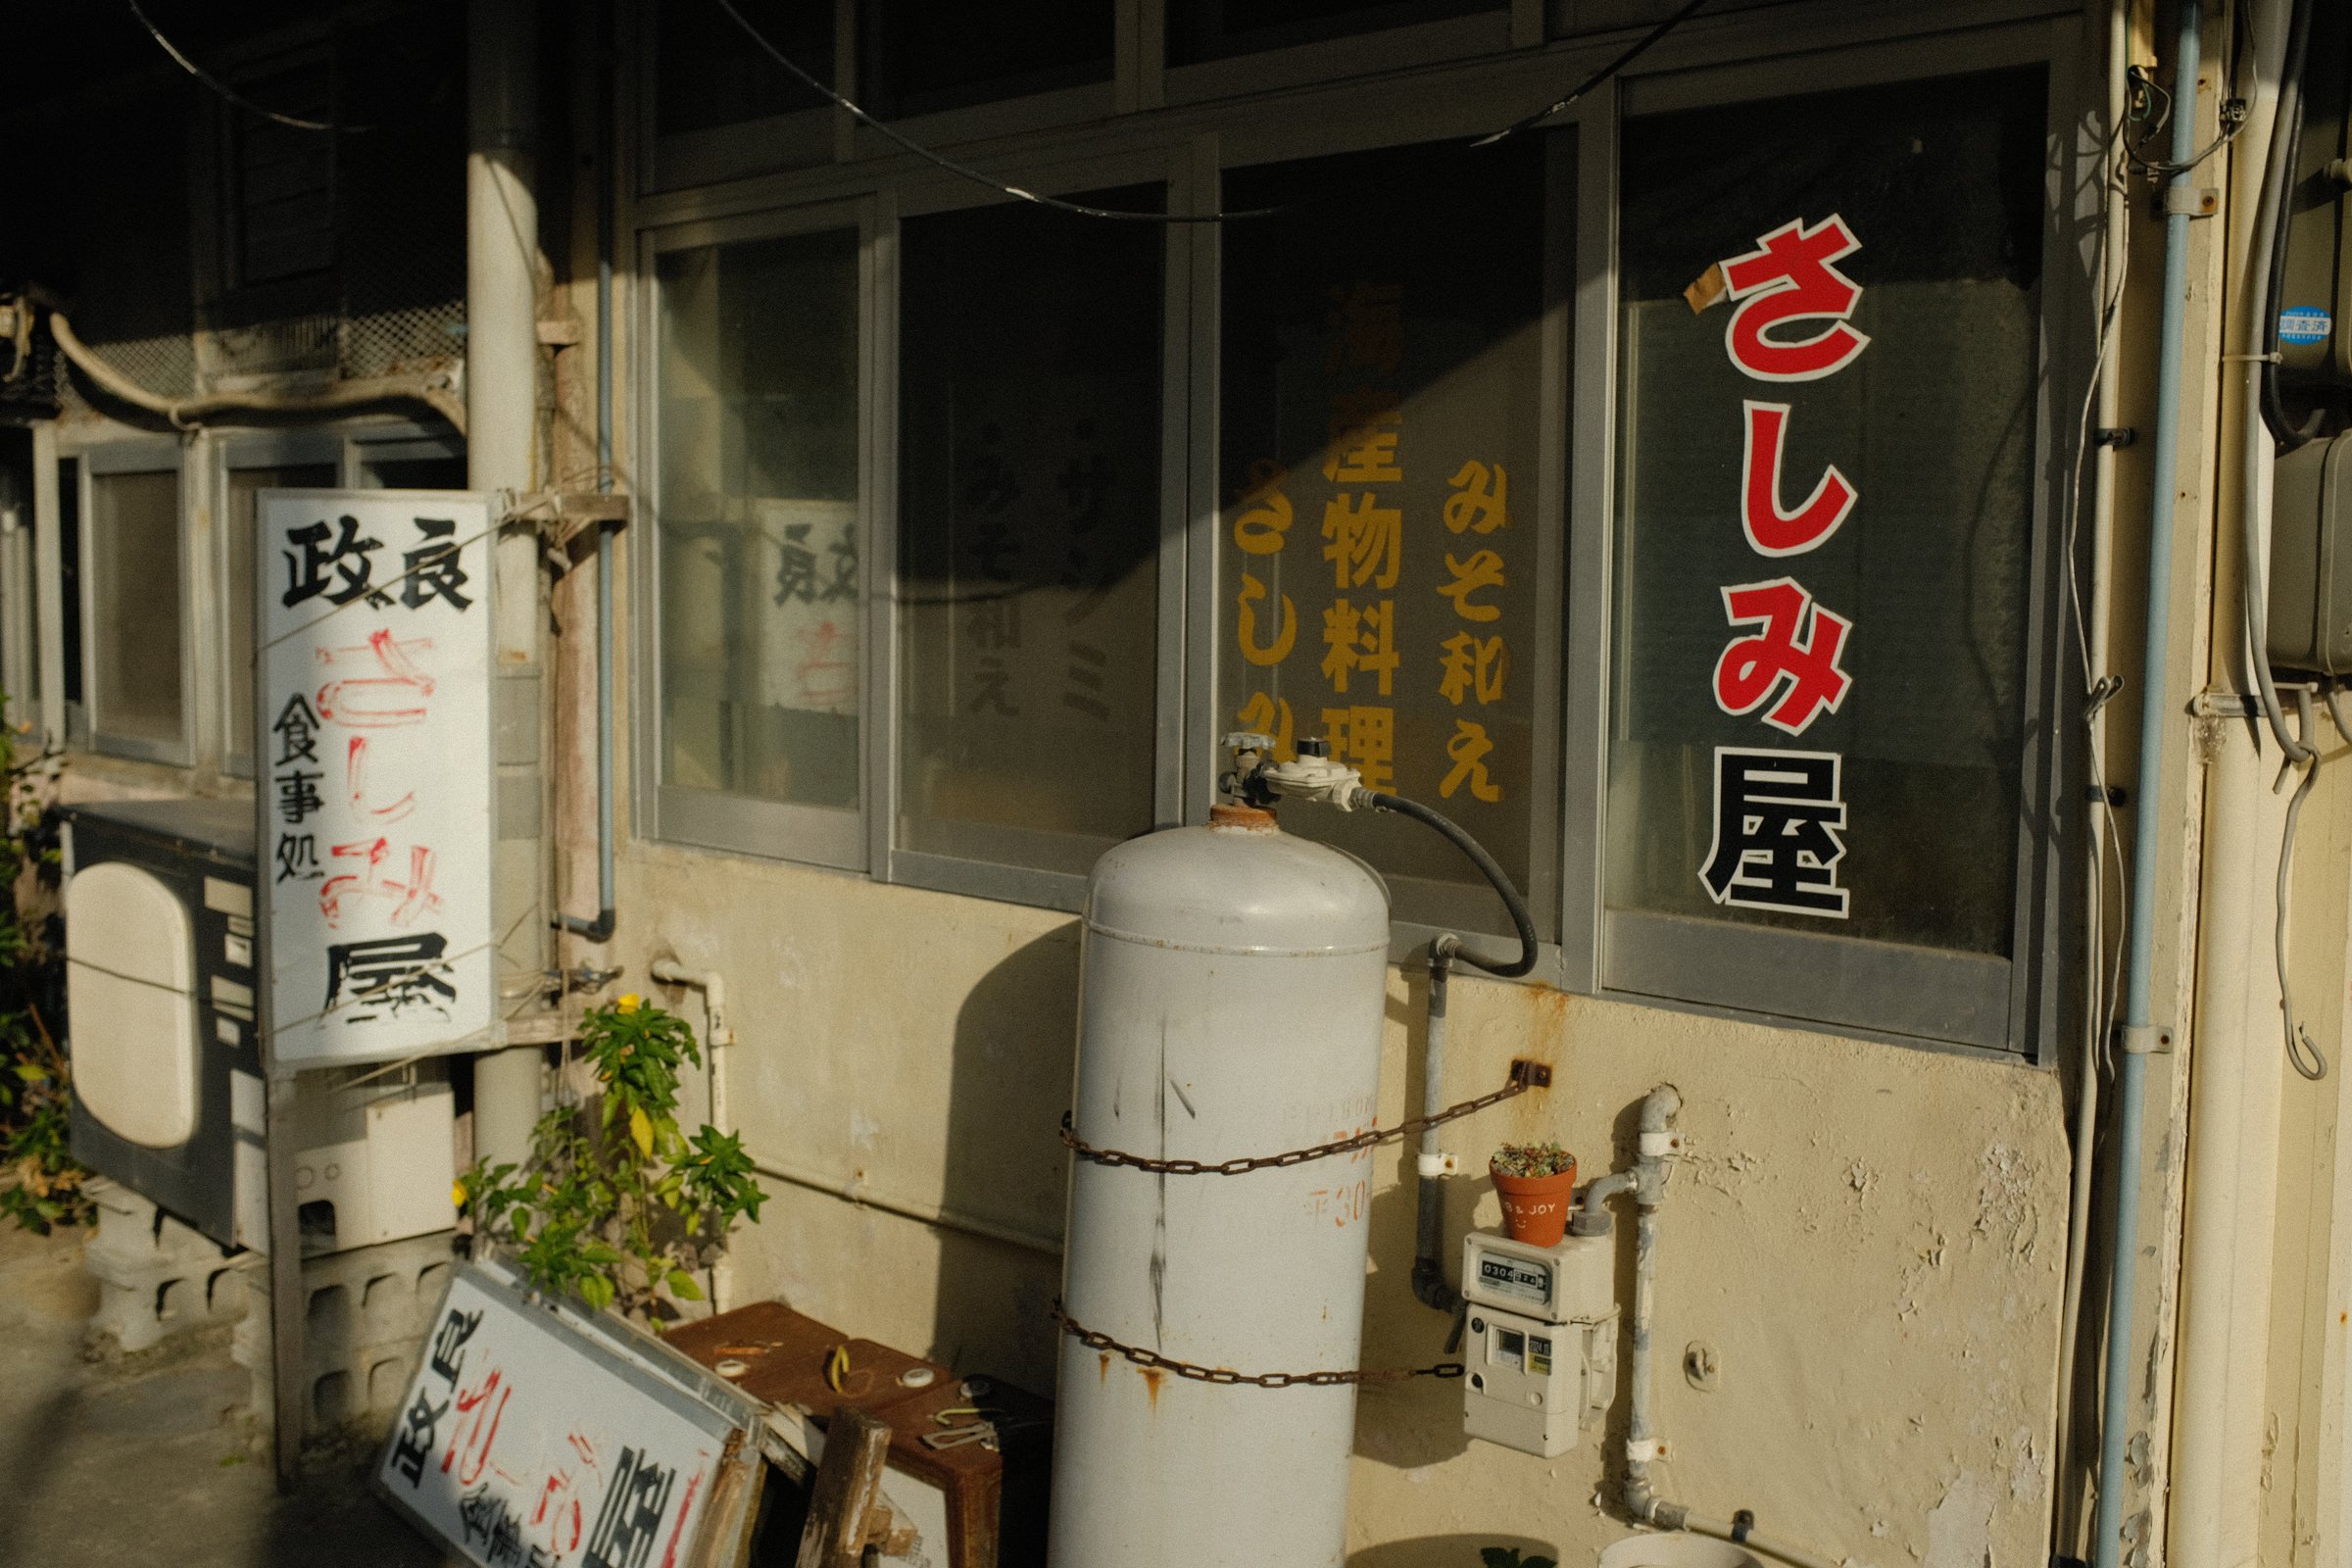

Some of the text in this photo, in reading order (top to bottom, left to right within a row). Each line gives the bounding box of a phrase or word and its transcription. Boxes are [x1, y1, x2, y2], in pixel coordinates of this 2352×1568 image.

[282, 515, 473, 612] 政良
[1437, 460, 1509, 803] みそ和え
[1697, 214, 1871, 919] さしみ屋
[273, 693, 325, 885] 食事処
[1529, 1203, 1556, 1215] JOY
[391, 1307, 484, 1489] 政良
